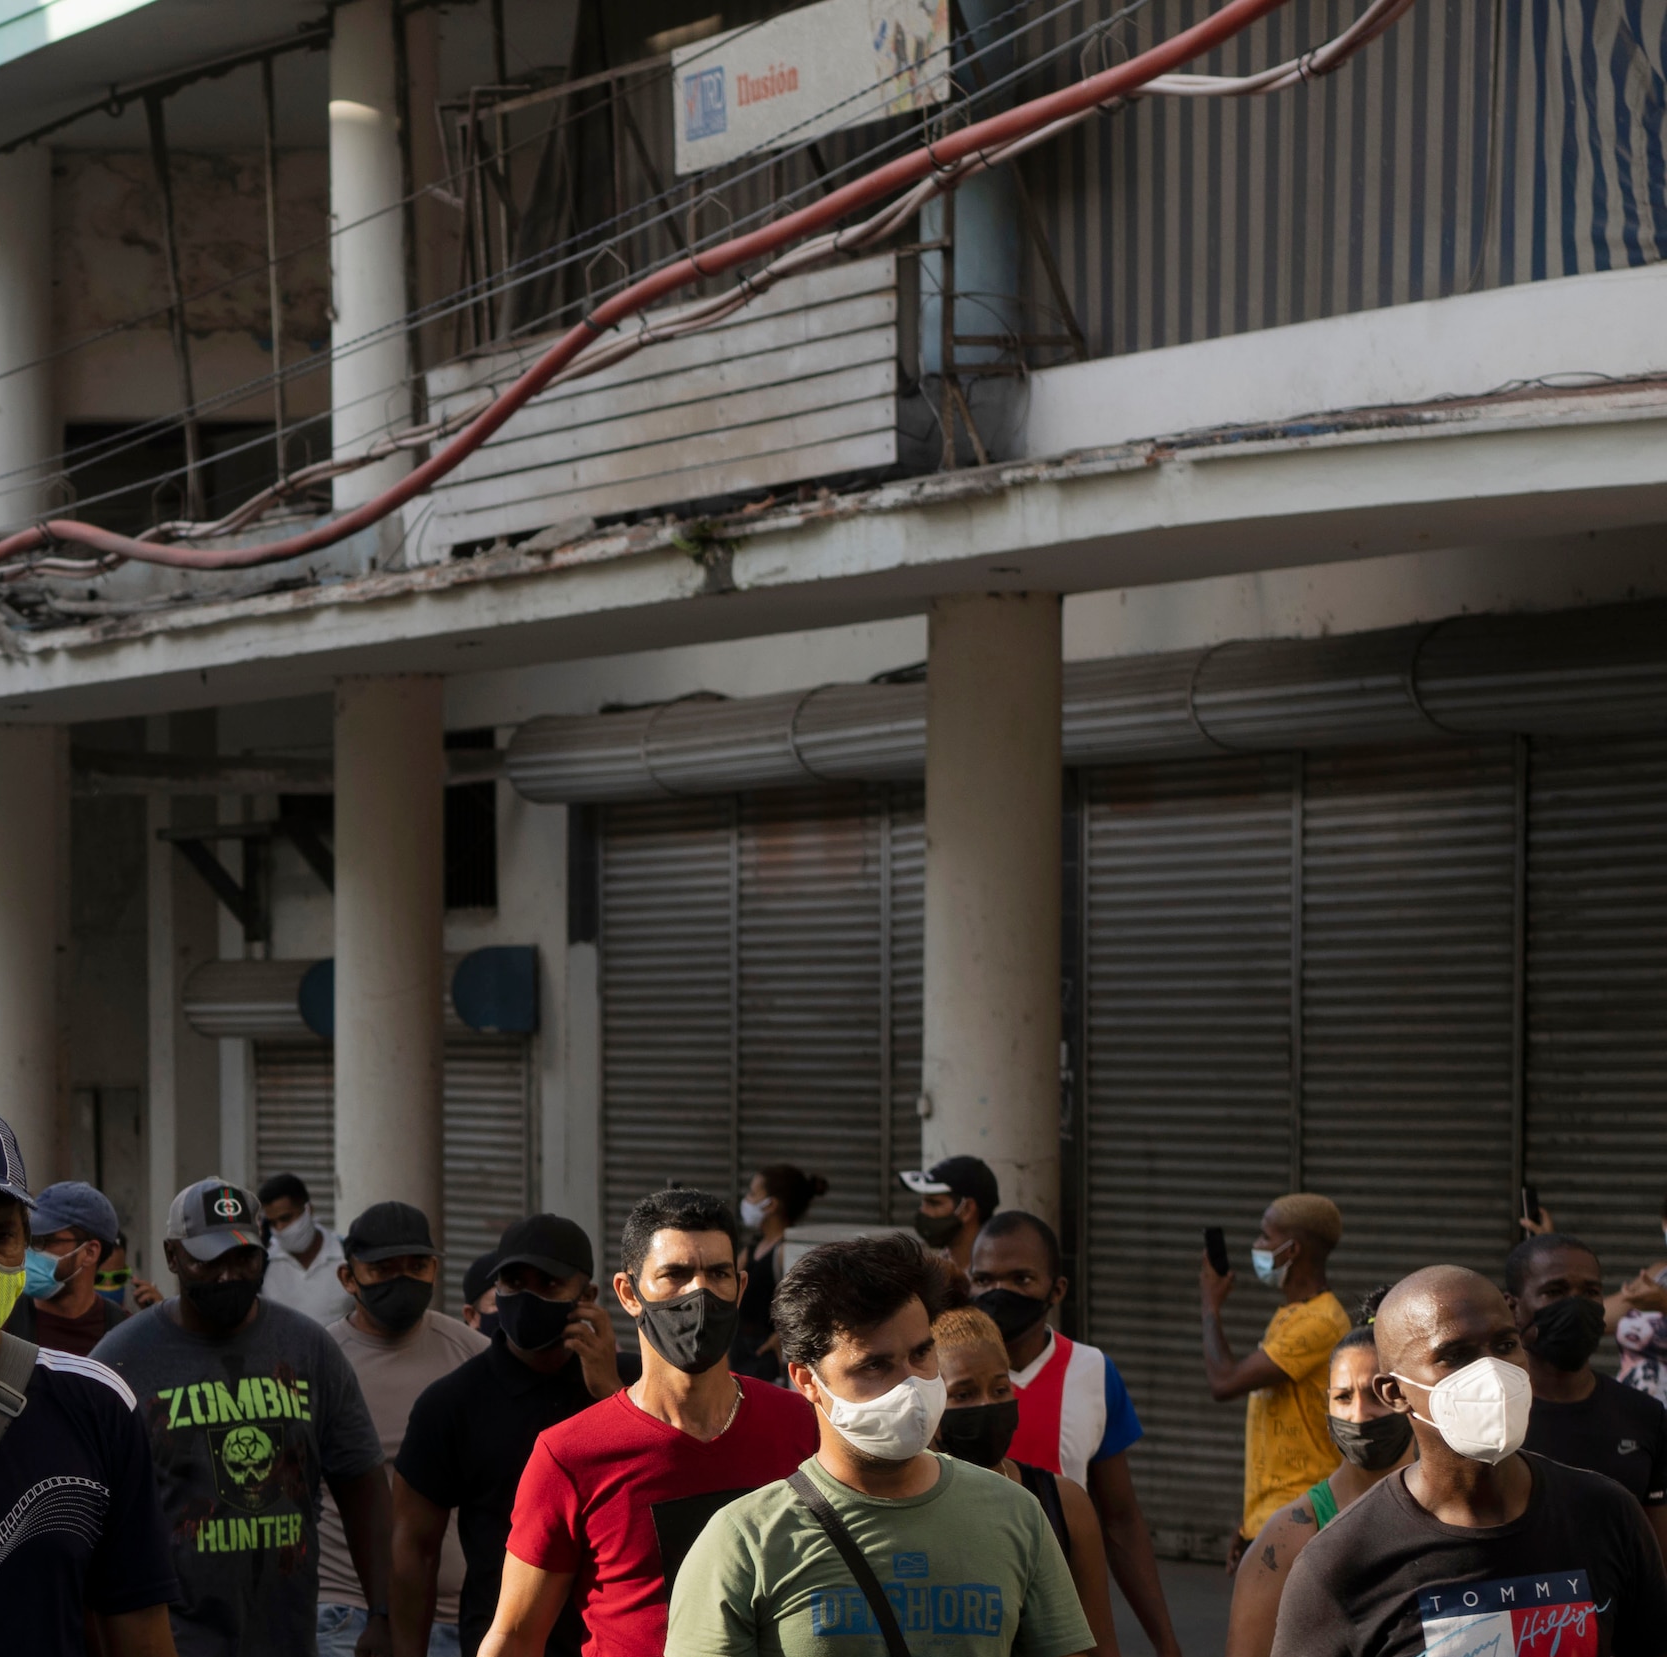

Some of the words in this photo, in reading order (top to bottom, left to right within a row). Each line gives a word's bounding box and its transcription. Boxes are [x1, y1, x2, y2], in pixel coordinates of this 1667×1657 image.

[736, 62, 799, 108] Ilusión
[157, 1377, 312, 1430] ZOMBIE
[196, 1513, 302, 1552] HUNTER
[1429, 1578, 1579, 1612] TOMMY
